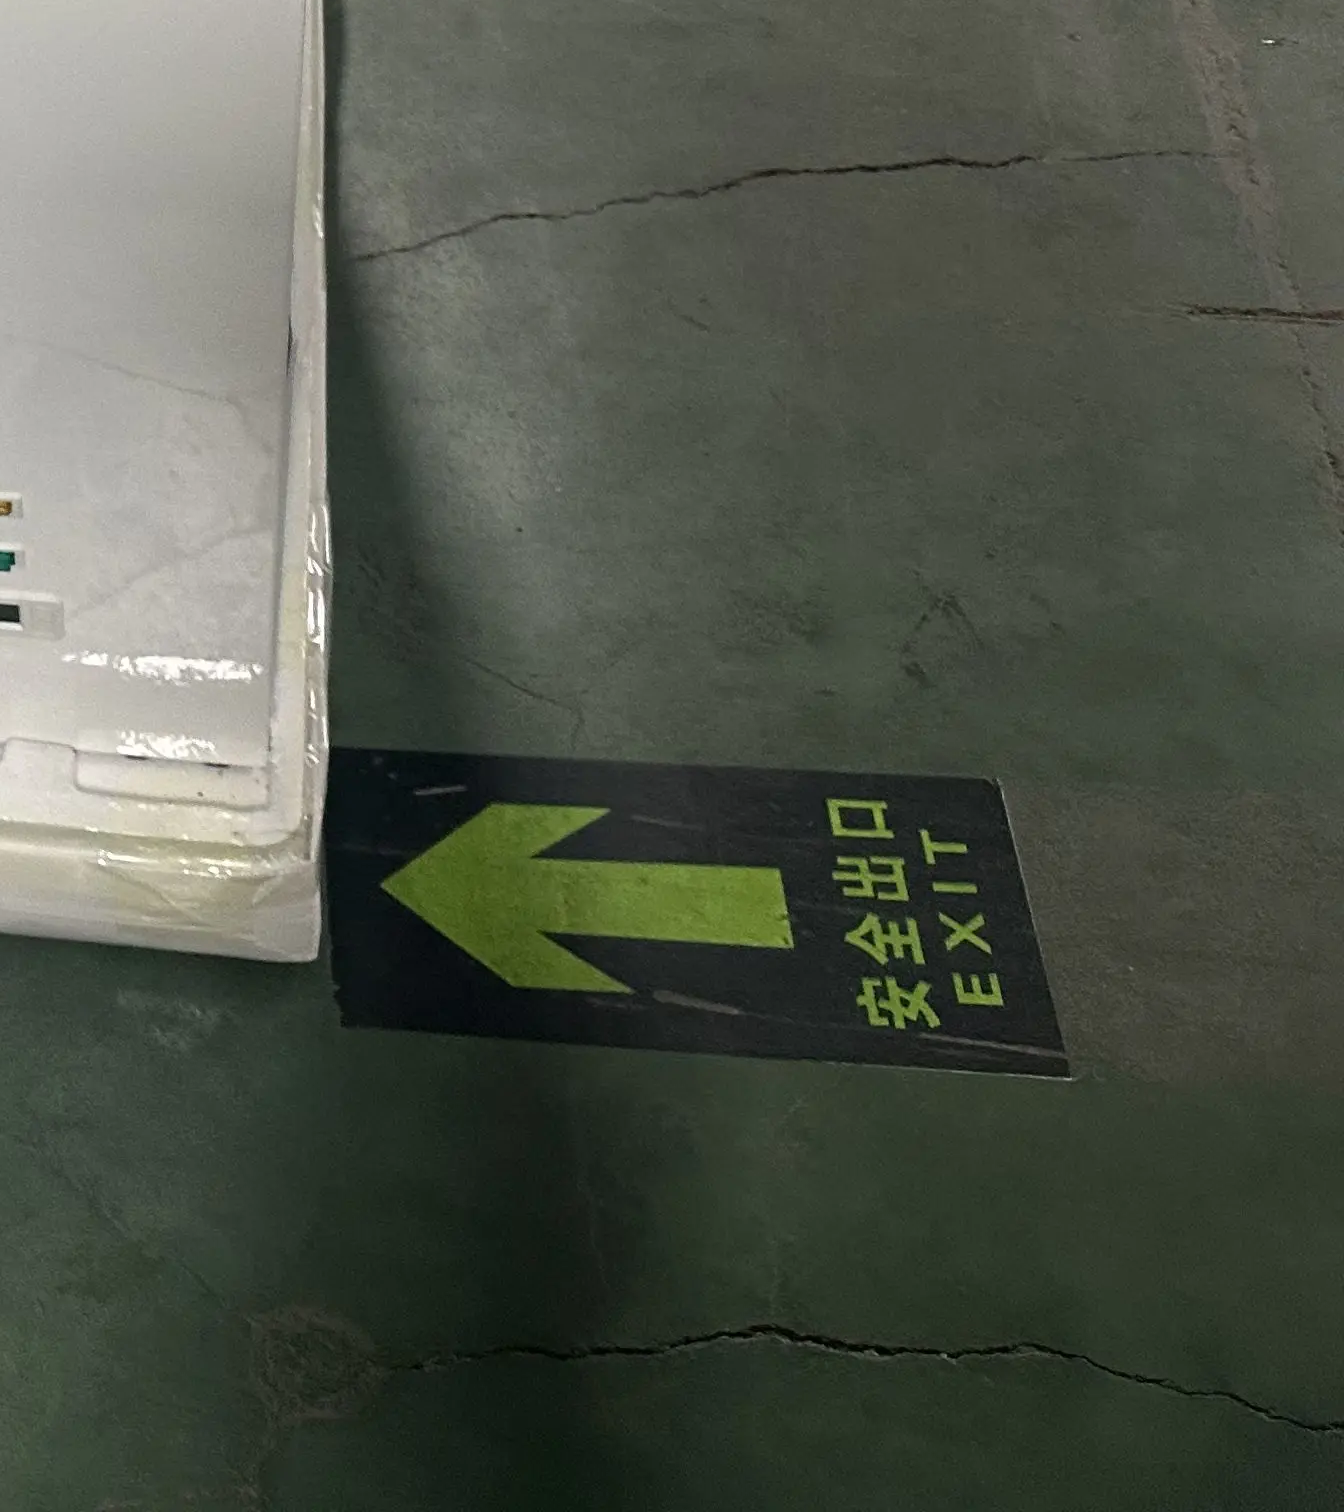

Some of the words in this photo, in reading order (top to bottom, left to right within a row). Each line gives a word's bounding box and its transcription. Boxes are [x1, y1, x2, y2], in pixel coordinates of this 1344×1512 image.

[825, 797, 942, 1030] 安全出口
[919, 829, 1004, 1007] EXIT
